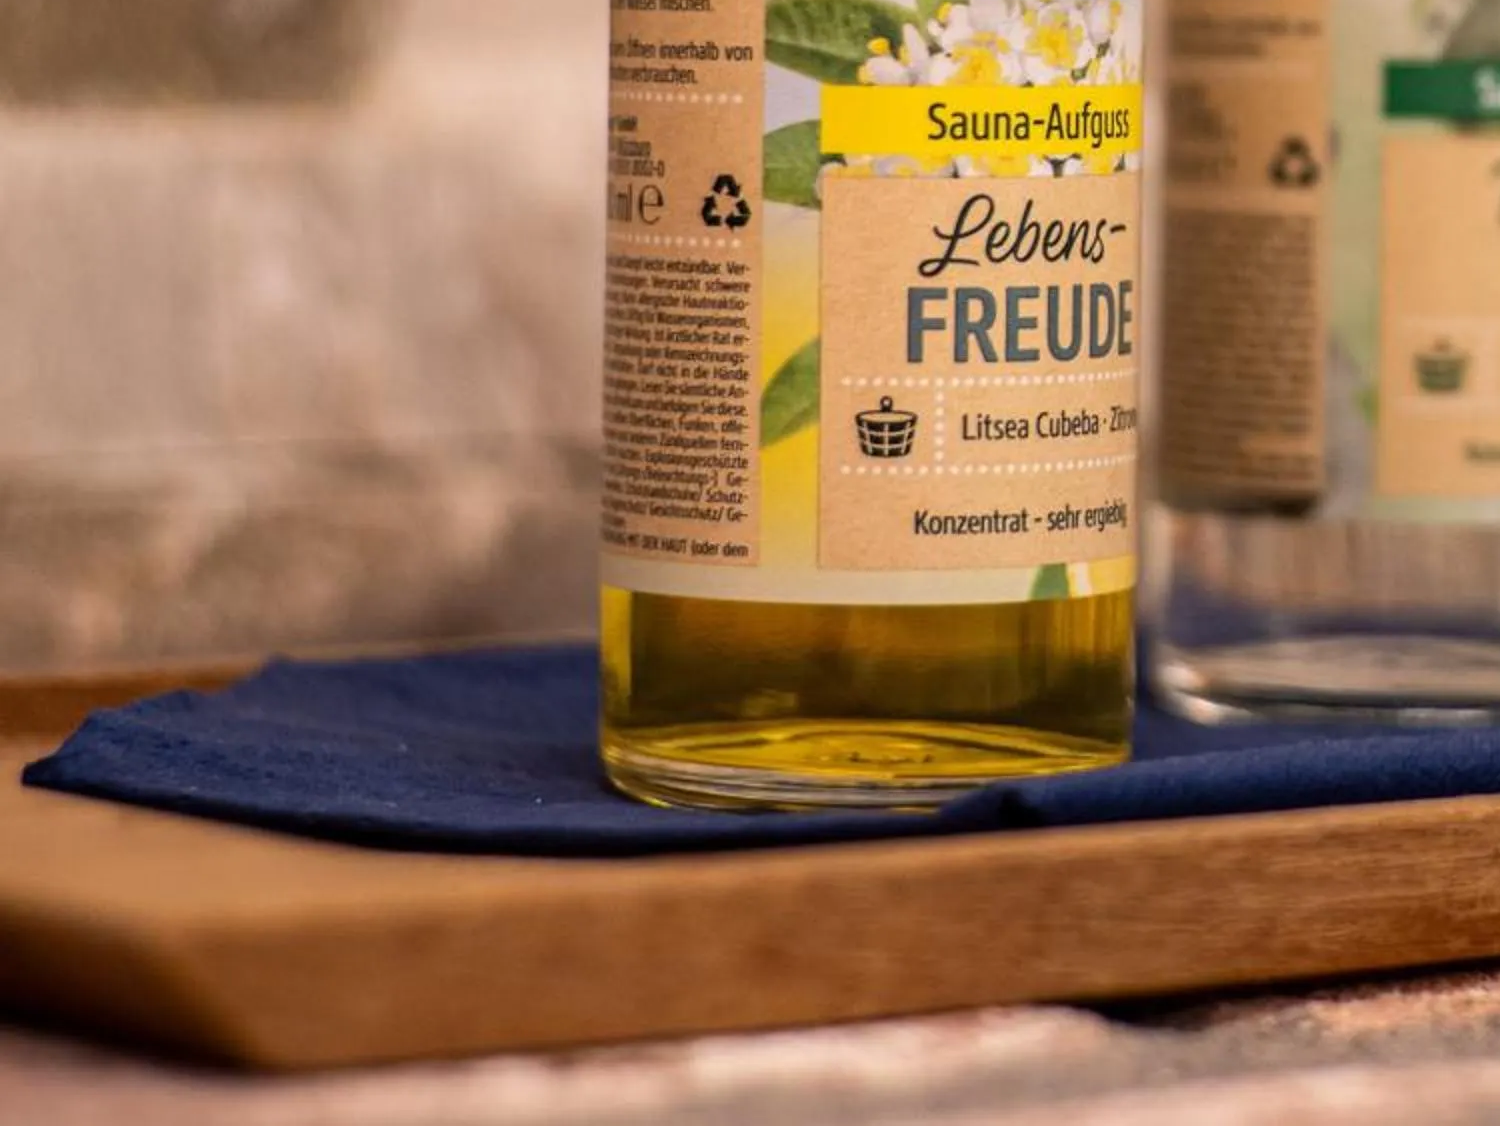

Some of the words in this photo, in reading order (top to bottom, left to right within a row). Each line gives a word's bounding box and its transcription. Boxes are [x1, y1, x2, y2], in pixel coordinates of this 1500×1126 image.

[724, 45, 753, 61] von
[927, 102, 1130, 149] Sauna-Aufguss
[917, 193, 1127, 278] Lebens-
[906, 280, 1133, 364] FREUDE
[961, 412, 1029, 441] Litsea
[1036, 408, 1099, 437] Cubeba
[914, 509, 1029, 535] Konzentrat
[1047, 503, 1081, 531] sehr
